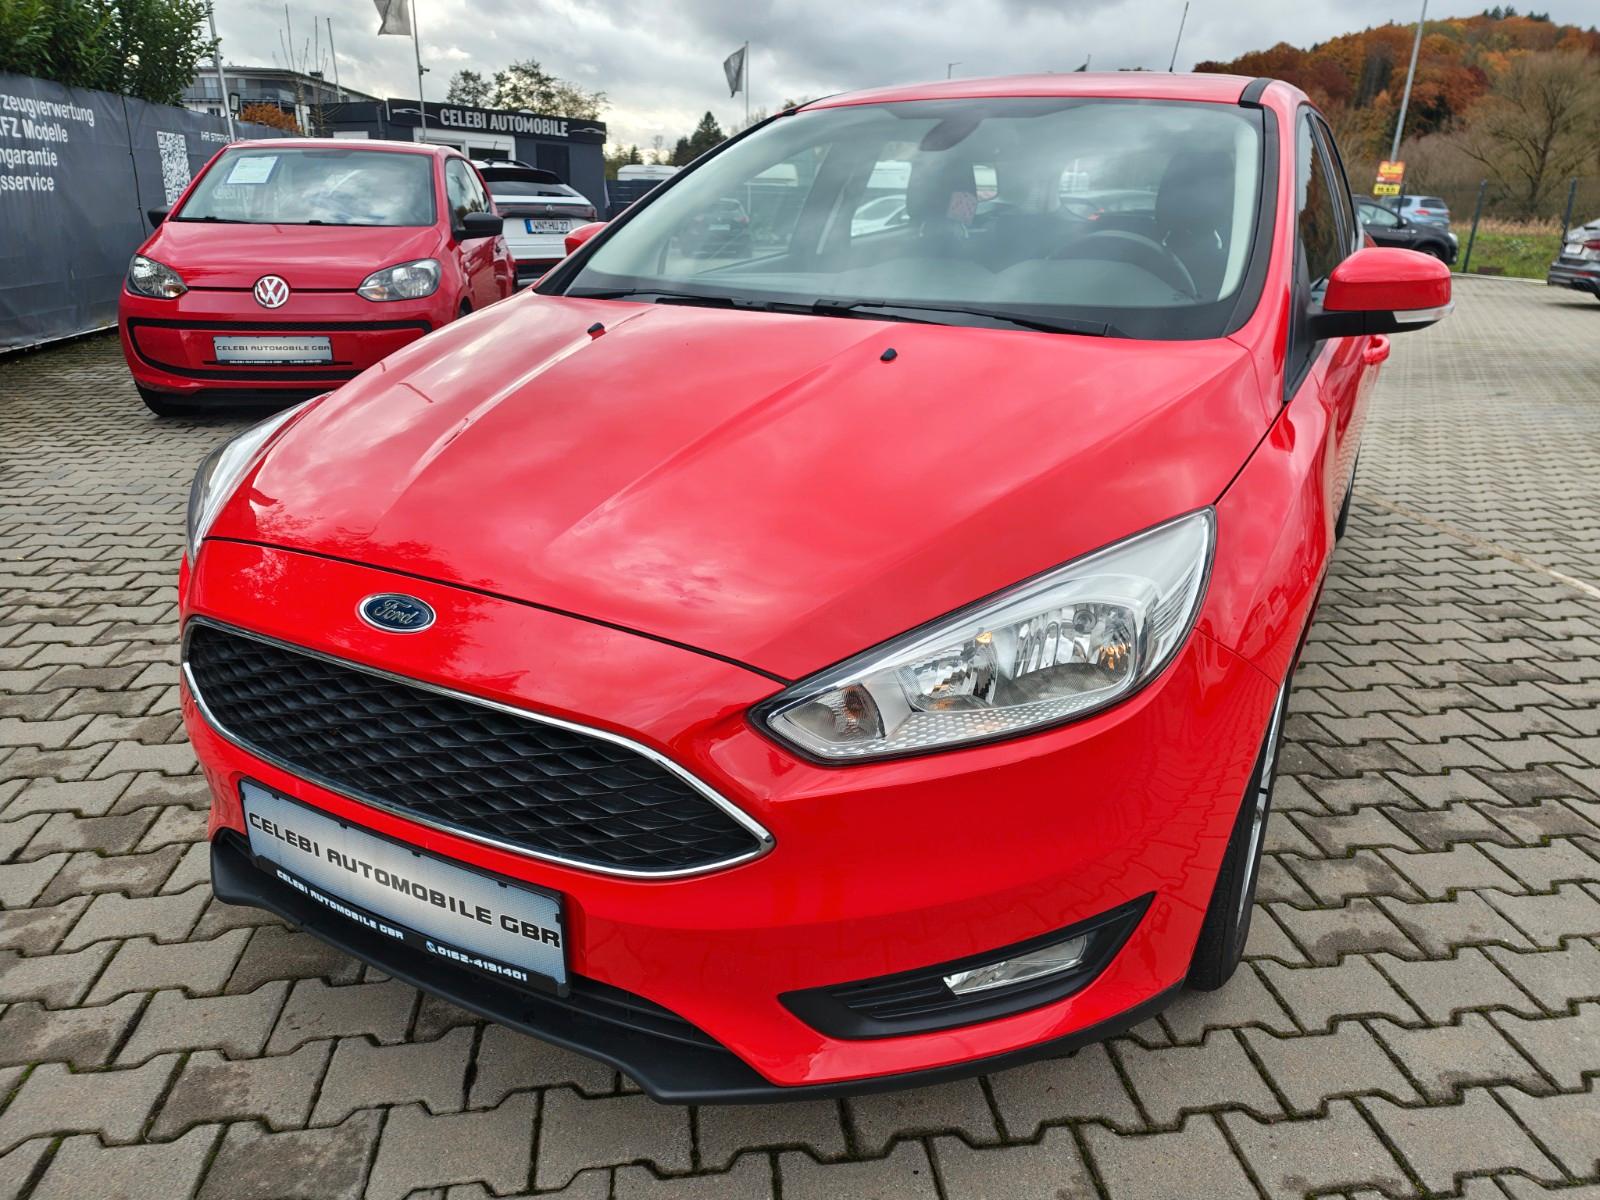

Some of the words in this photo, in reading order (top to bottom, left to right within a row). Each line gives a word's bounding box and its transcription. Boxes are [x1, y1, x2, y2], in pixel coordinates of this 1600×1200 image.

[0, 94, 95, 127] zeugverwertung
[440, 108, 487, 129] CELEBI
[490, 114, 569, 137] AUTOMOBILE
[22, 119, 69, 143] Modelle
[0, 172, 55, 196] sservice
[374, 599, 419, 624] Ford
[248, 812, 320, 857] CELEBI
[326, 847, 492, 925] AUTOMOBILE
[500, 915, 560, 949] GBR
[276, 870, 309, 894] CELEBI
[311, 889, 377, 929] AUTOMOBILE
[379, 923, 404, 940] GBR
